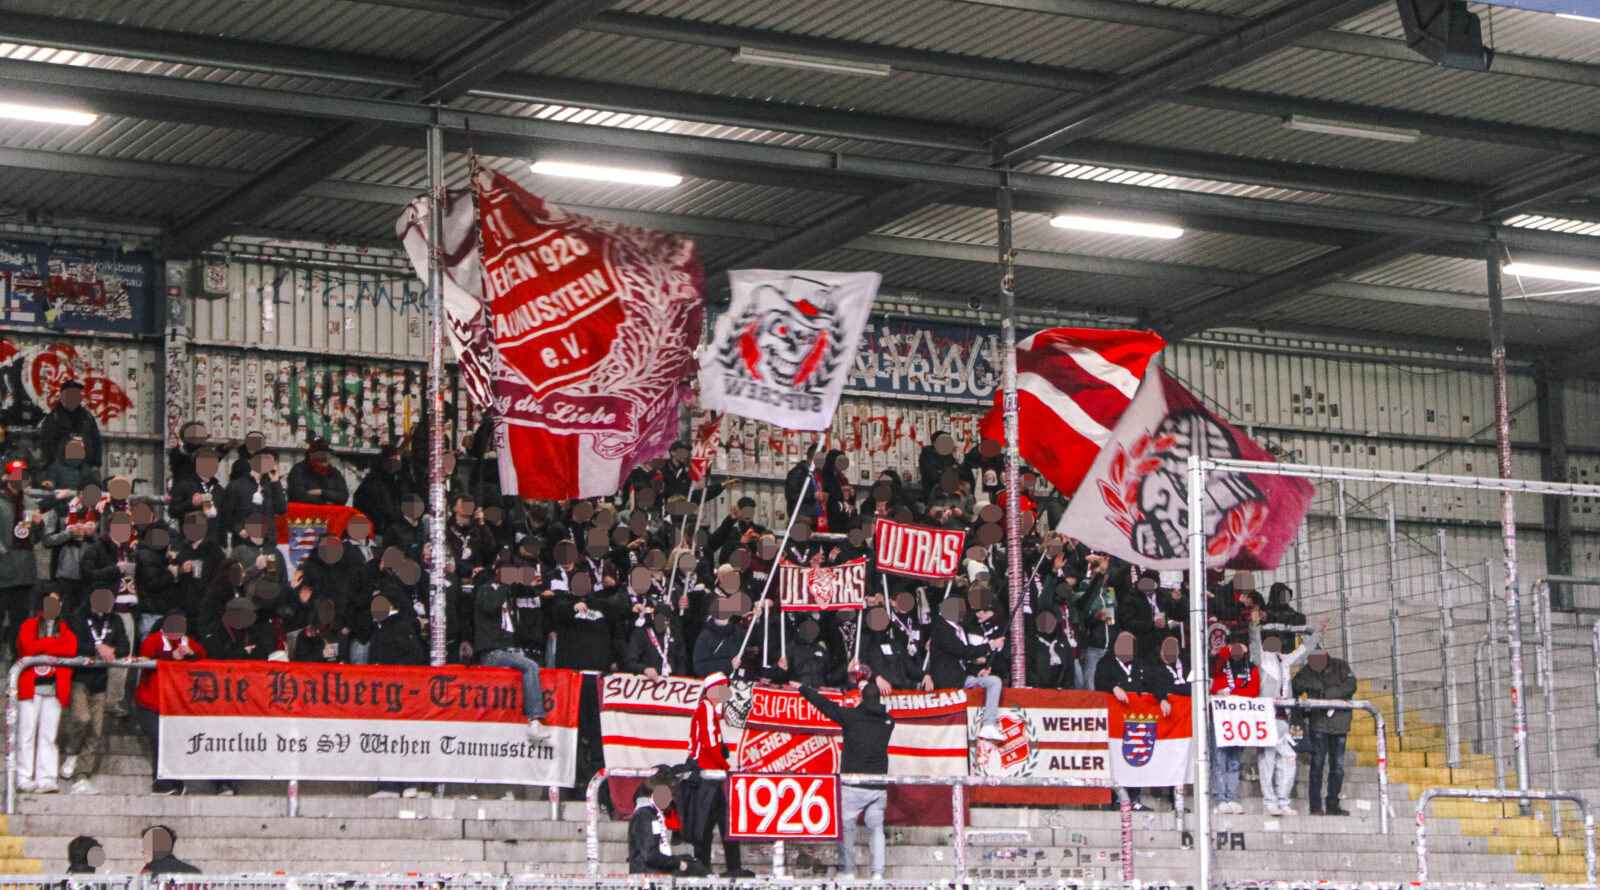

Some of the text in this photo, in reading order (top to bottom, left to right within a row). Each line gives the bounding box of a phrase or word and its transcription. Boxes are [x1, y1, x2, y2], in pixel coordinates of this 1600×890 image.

[540, 333, 588, 368] e.V.
[546, 402, 616, 424] Liebe
[878, 523, 959, 574] ULTRAS
[187, 667, 557, 713] Die Halberg-Trams
[1214, 699, 1266, 712] Mocke
[1042, 717, 1107, 732] WEHEN
[1222, 720, 1268, 741] 305
[186, 732, 555, 760] Fanclub des SV Wehen Taunusstein
[1049, 755, 1104, 770] ALLER
[734, 777, 832, 834] 1926
